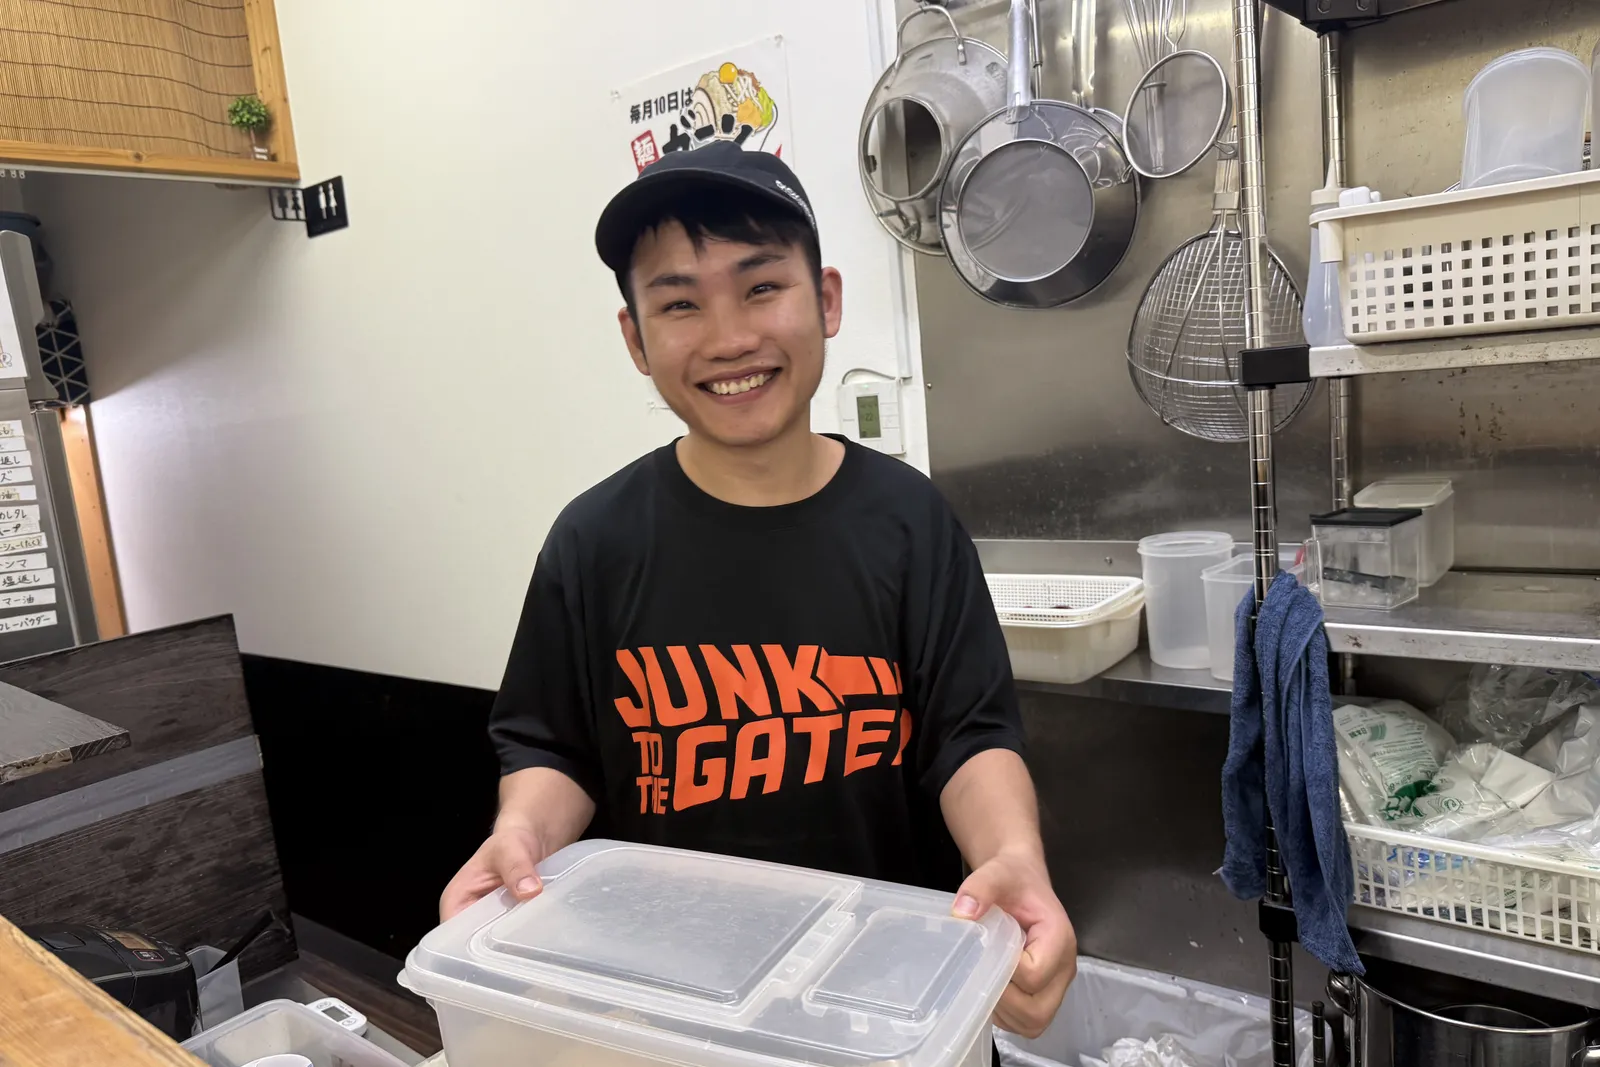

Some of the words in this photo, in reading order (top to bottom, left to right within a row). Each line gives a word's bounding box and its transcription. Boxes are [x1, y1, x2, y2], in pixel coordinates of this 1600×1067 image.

[629, 86, 694, 124] 毎月10日は
[0, 558, 27, 569] ンマ
[613, 644, 838, 728] JUNK
[632, 731, 664, 776] TO
[636, 775, 670, 815] THE
